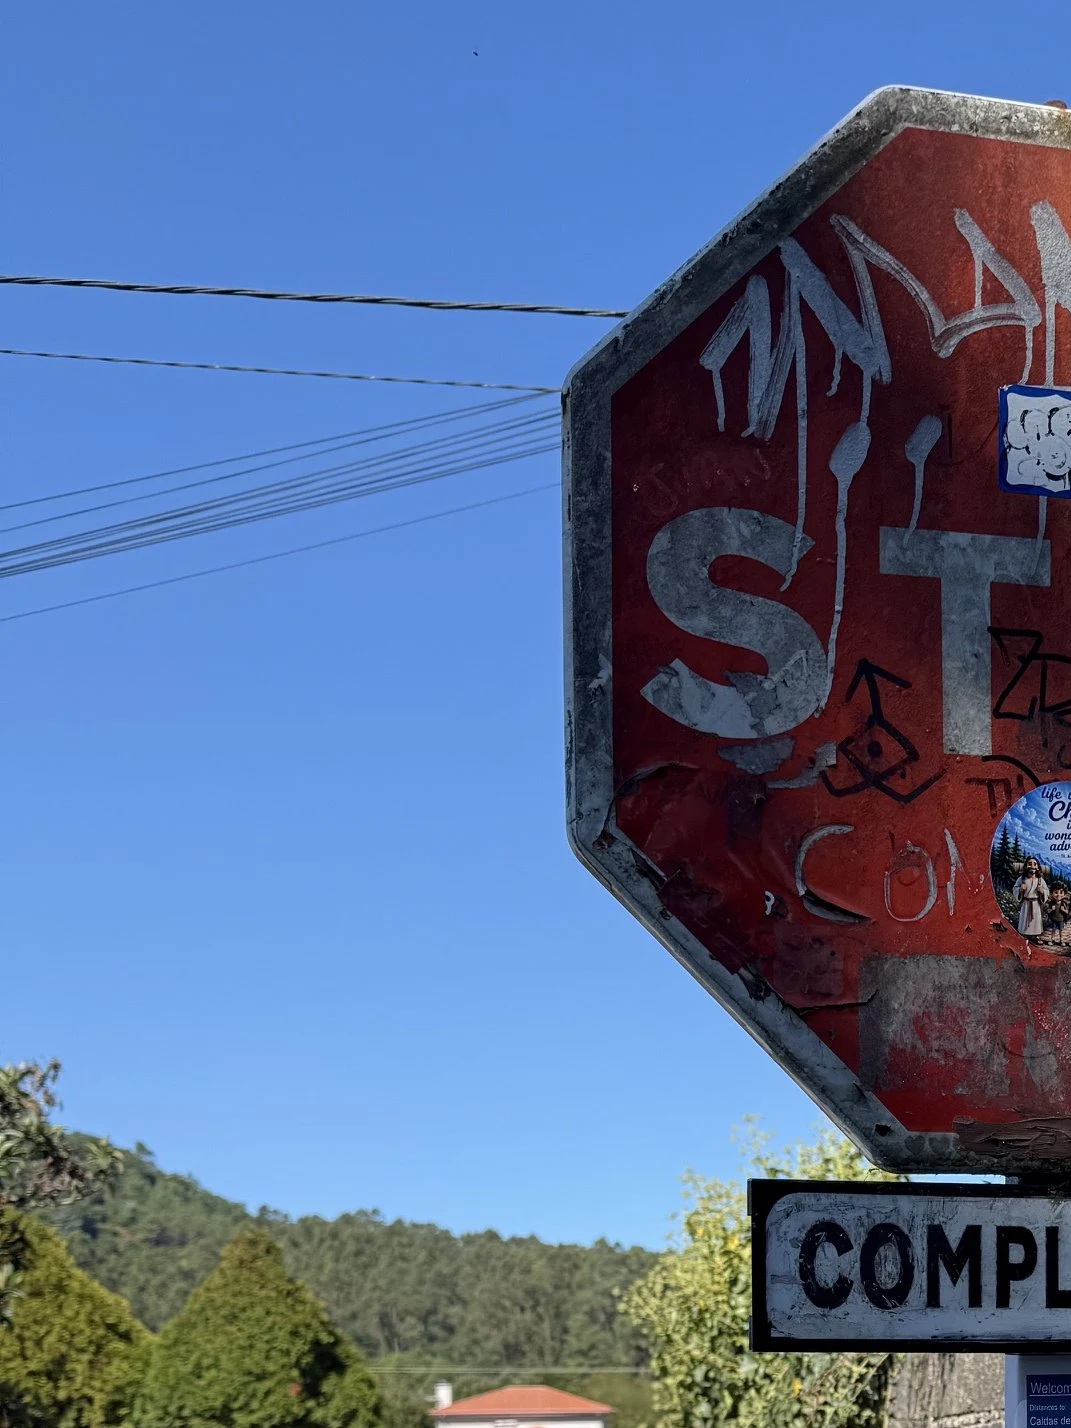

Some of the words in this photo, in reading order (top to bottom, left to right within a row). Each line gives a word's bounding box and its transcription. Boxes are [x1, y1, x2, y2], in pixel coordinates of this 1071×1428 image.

[1041, 786, 1062, 802] life
[1029, 1416, 1058, 1426] Caldas
[1060, 1416, 1071, 1425] de
